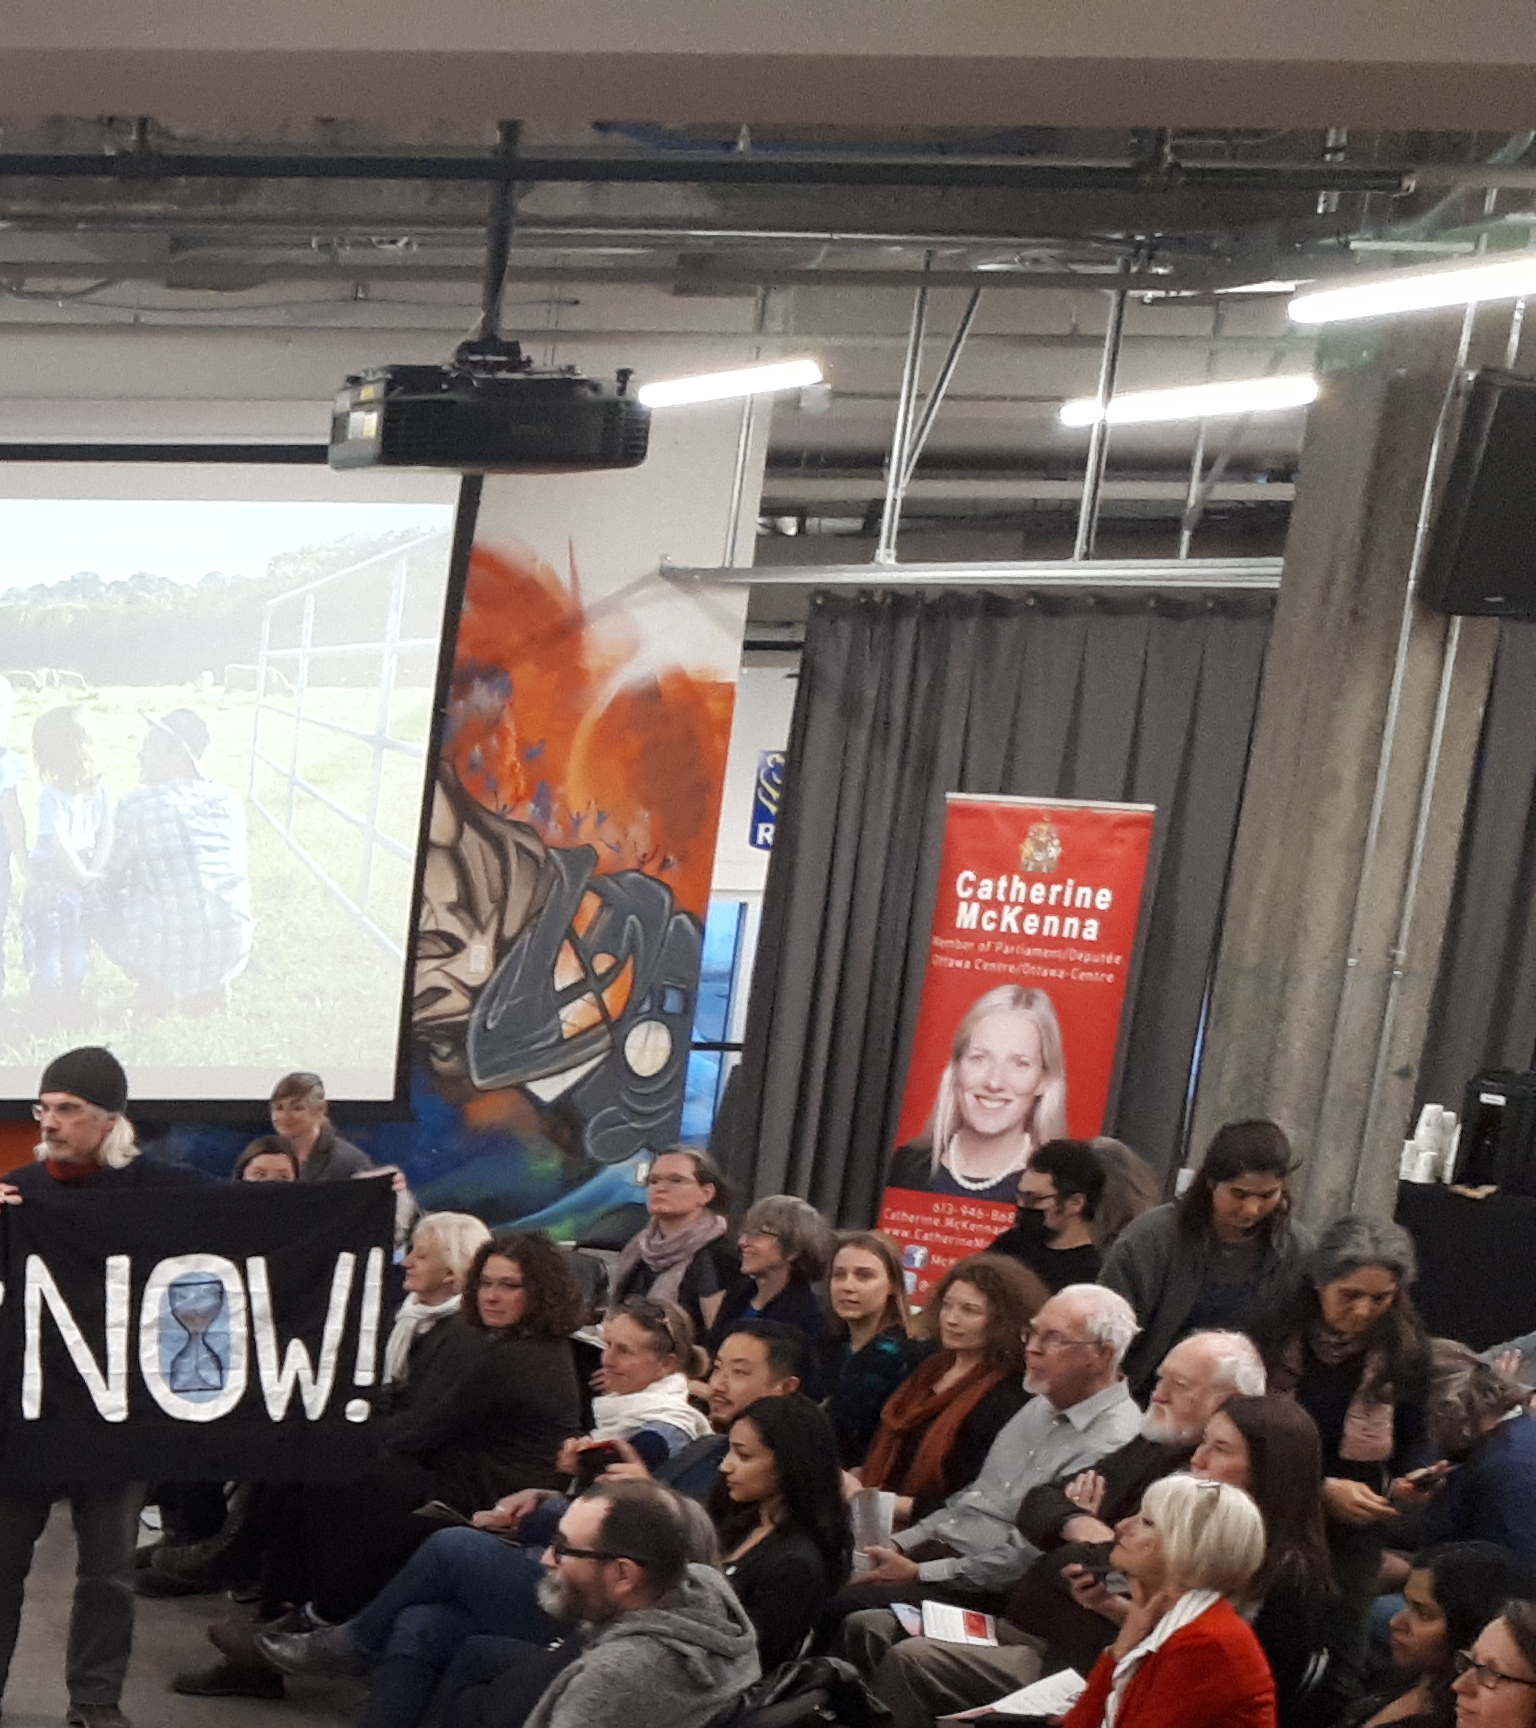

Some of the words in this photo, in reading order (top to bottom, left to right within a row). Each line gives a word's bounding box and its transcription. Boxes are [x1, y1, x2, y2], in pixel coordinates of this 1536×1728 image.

[955, 869, 1113, 911] Catherine
[955, 900, 1100, 941] McKenna
[931, 1202, 1016, 1223] 613-946-868
[22, 1246, 384, 1424] NOW!
